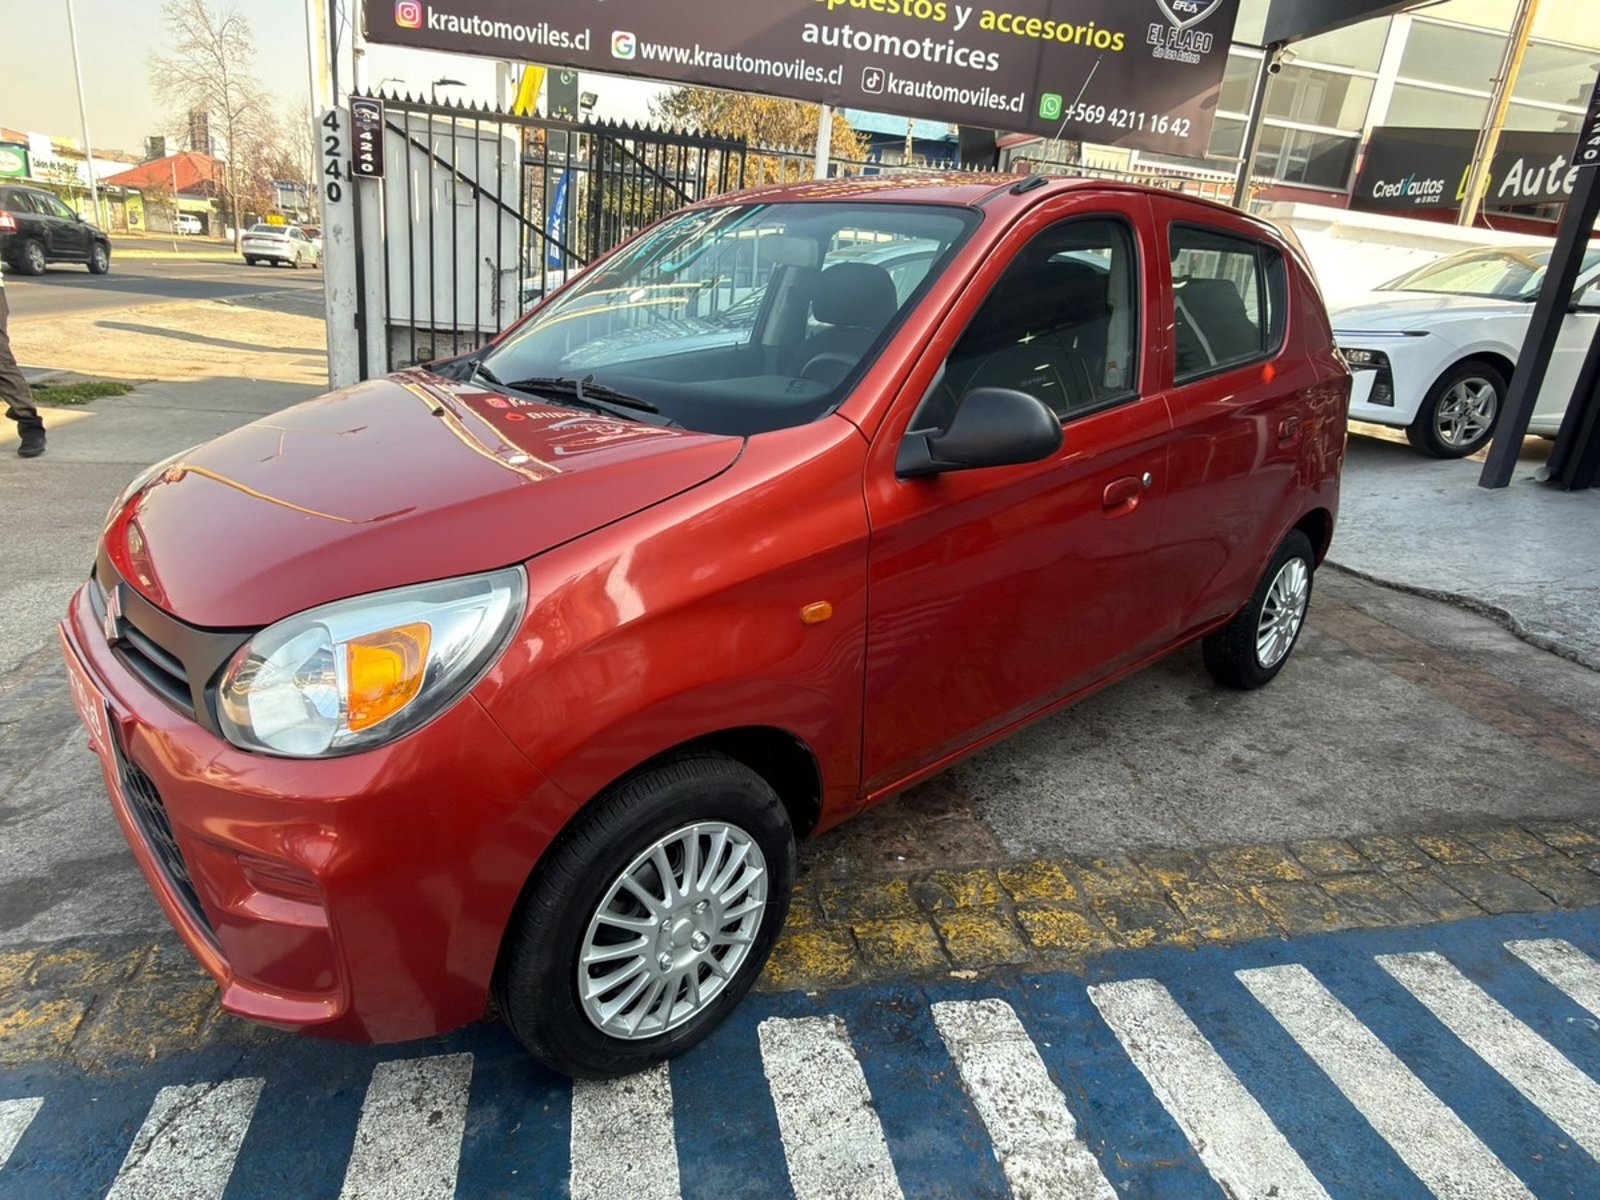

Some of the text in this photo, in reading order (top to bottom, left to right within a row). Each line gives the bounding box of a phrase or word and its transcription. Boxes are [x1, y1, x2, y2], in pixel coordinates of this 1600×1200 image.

[427, 6, 591, 51] krautomoviles.cl
[802, 22, 1000, 71] automotrices
[953, 4, 973, 32] y
[979, 9, 1125, 51] accesorios
[1146, 22, 1213, 54] EL FLACO
[640, 42, 843, 85] www.krautomoviles.cl
[887, 73, 1025, 112] krautomoviles.cl
[1065, 103, 1191, 137] +569 4211 16 42
[1583, 112, 1600, 160] 240
[322, 110, 342, 203] 4240
